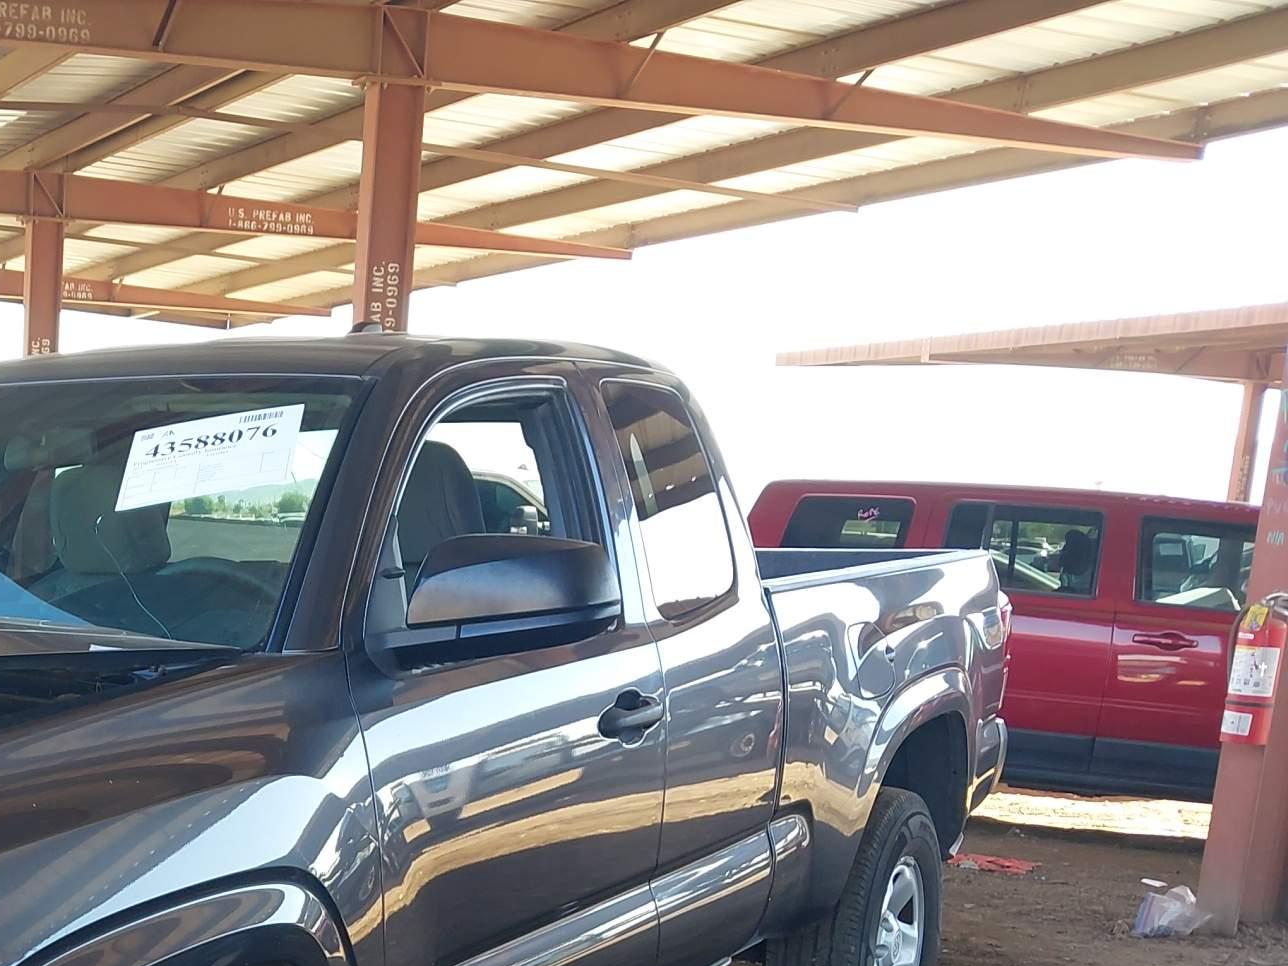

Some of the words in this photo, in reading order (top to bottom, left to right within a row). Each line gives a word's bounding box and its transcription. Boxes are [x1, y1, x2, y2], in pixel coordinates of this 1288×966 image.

[61, 7, 92, 26] INC.
[252, 209, 292, 223] PREFAB
[296, 212, 315, 225] INC.
[371, 261, 385, 293] INC.
[145, 423, 279, 458] 43588076
